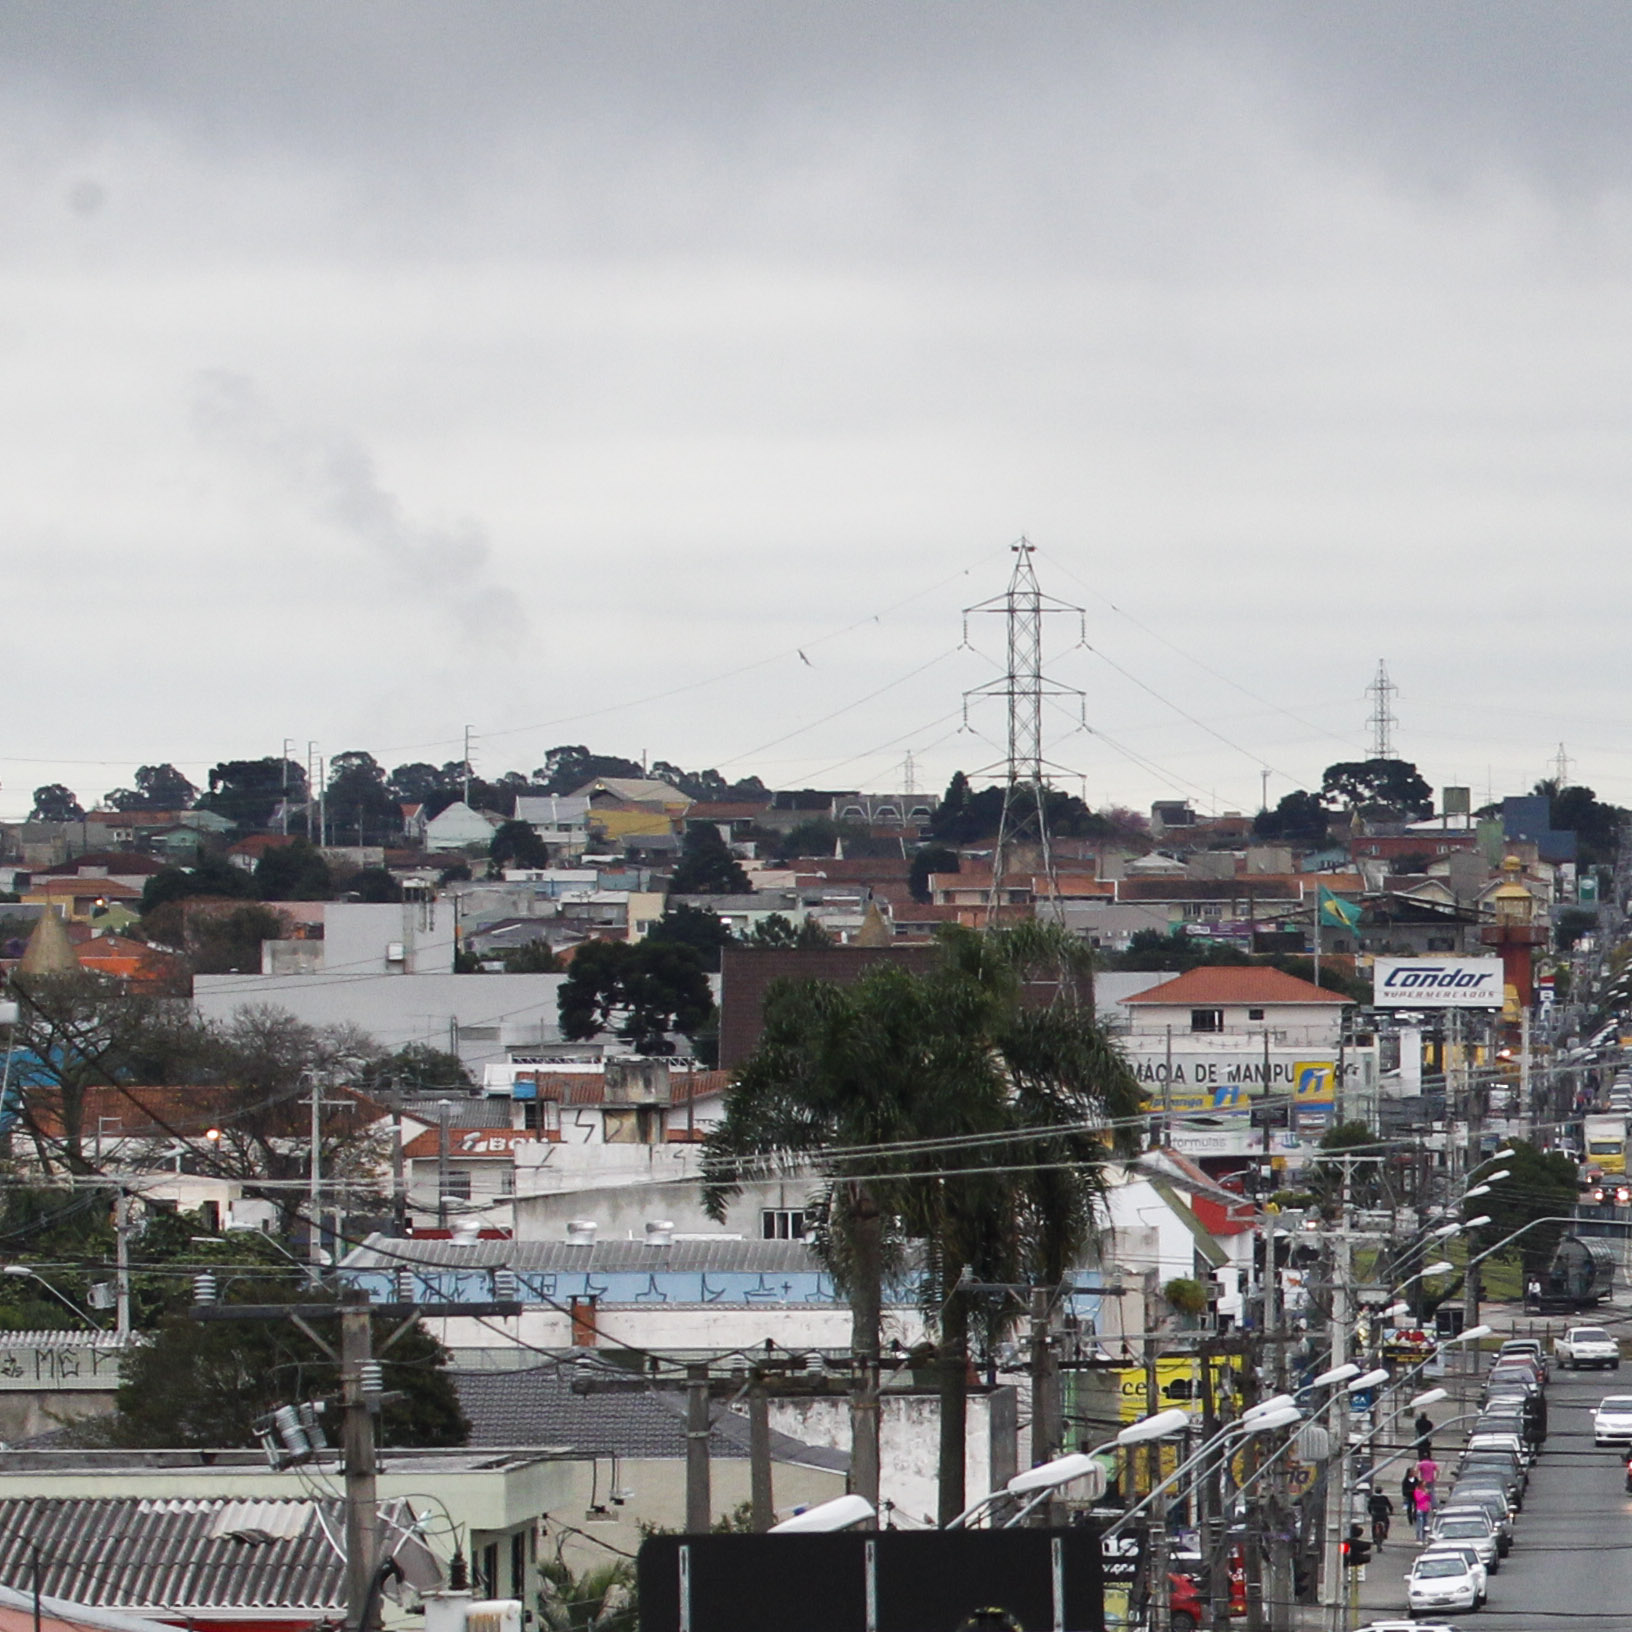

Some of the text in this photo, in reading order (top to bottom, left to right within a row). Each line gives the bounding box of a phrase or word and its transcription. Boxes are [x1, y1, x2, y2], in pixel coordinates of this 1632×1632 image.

[1383, 966, 1495, 988] Condor
[1383, 990, 1495, 998] SUPERMERCADOS
[1196, 1063, 1218, 1083] DE
